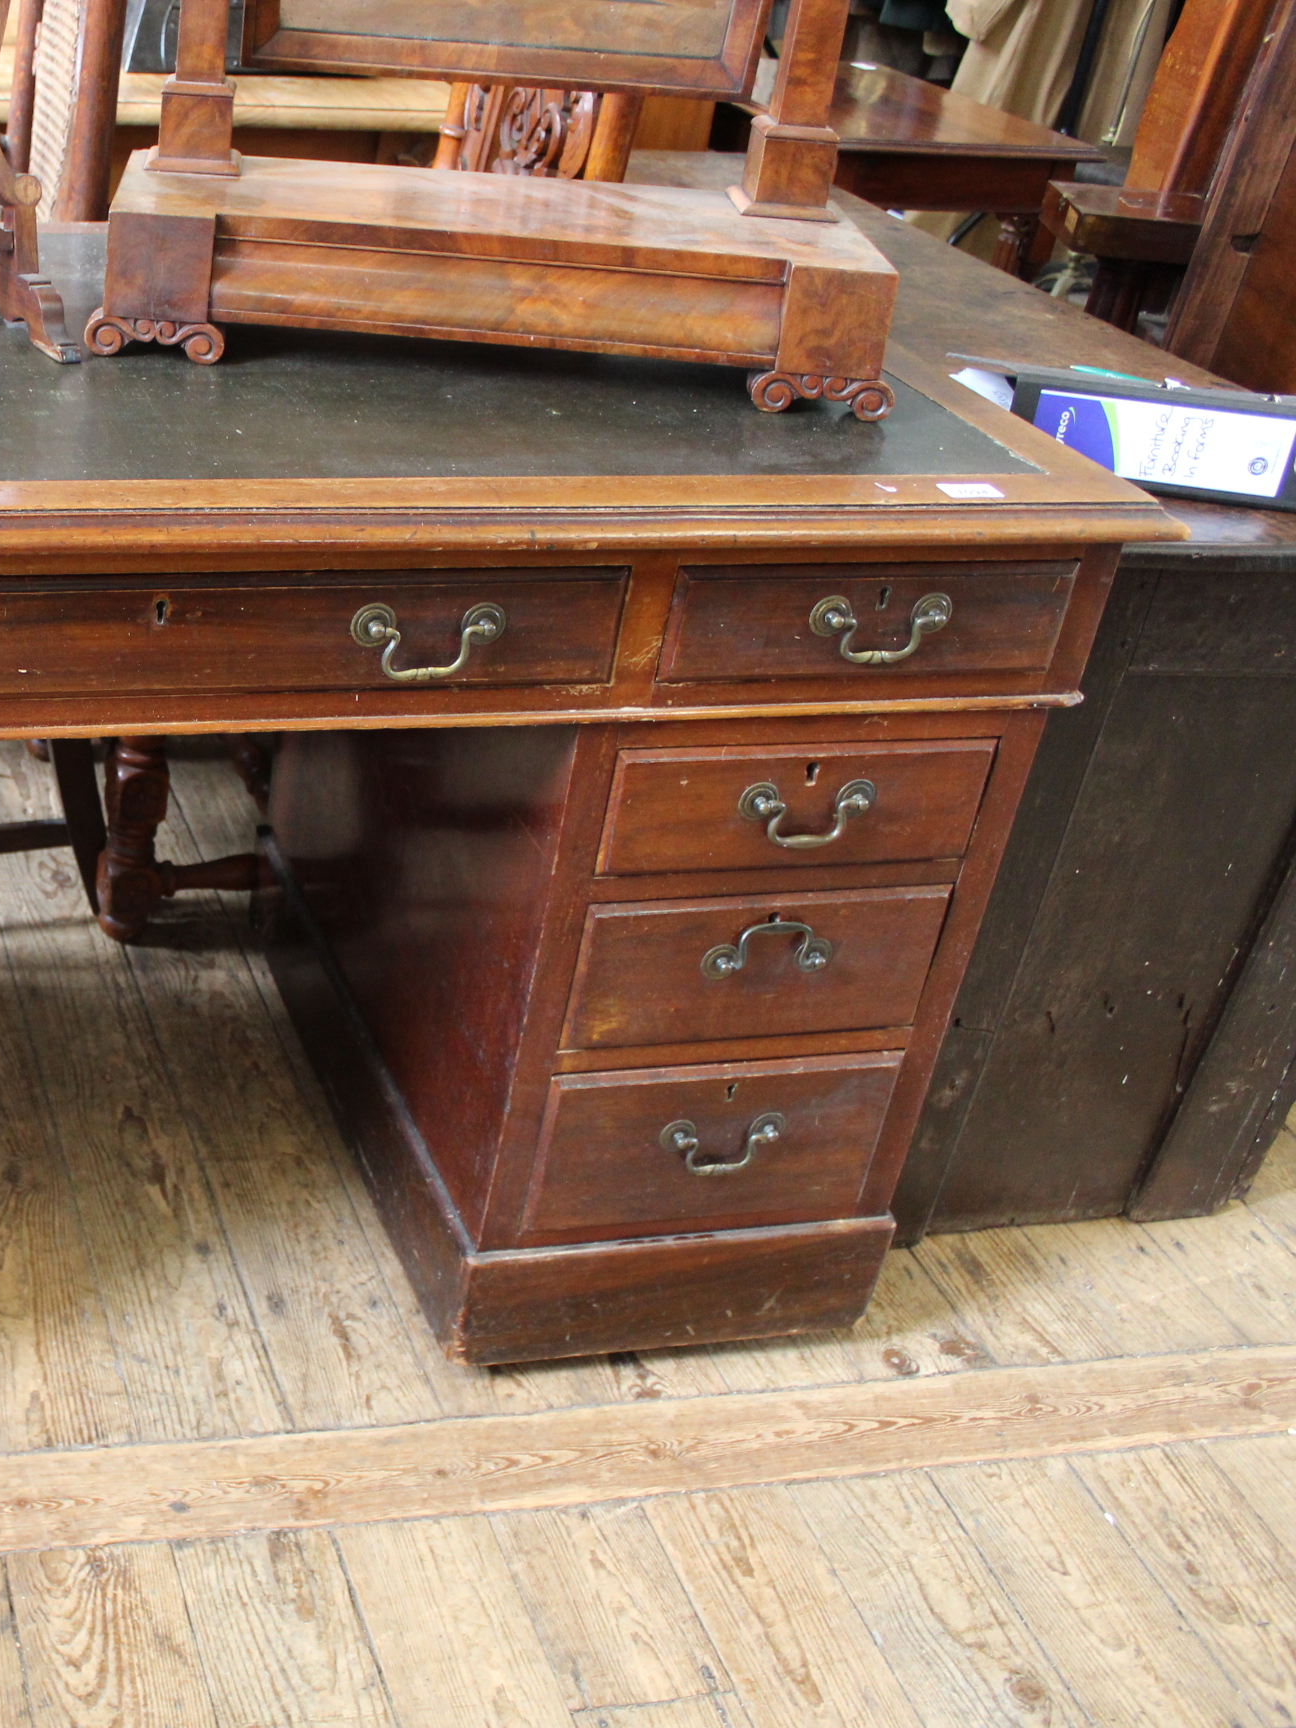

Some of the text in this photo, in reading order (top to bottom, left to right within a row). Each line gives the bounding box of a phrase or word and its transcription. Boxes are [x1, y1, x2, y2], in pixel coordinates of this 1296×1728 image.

[1138, 405, 1173, 477] Furniture
[1162, 416, 1203, 476] Booking
[1182, 466, 1198, 478] In
